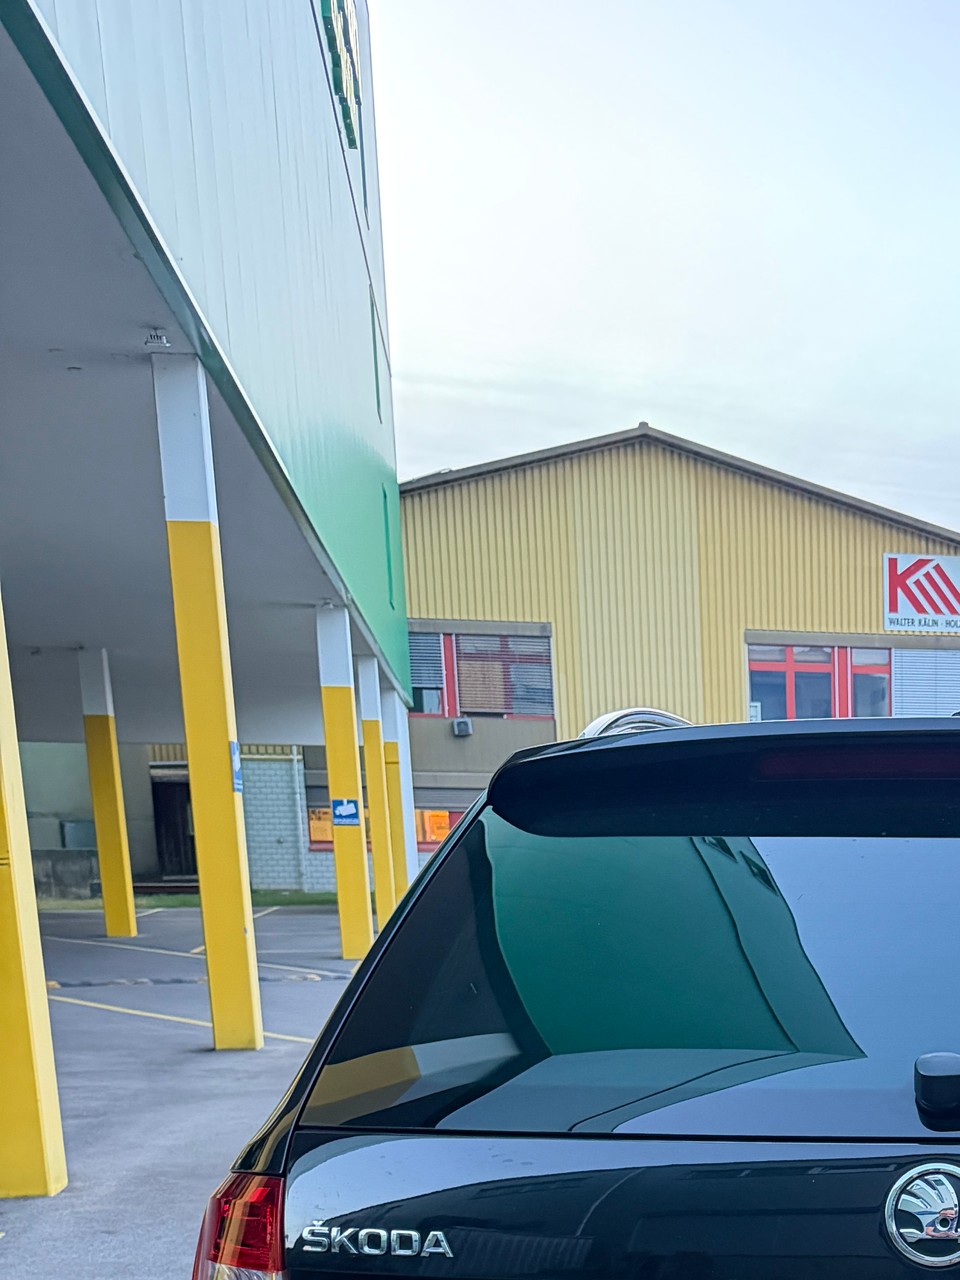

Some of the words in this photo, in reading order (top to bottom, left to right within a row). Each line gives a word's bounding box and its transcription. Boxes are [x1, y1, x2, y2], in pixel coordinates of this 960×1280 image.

[888, 617, 916, 628] WALTER
[918, 617, 939, 628] KÄLIN
[301, 1220, 454, 1258] ŠKODA
